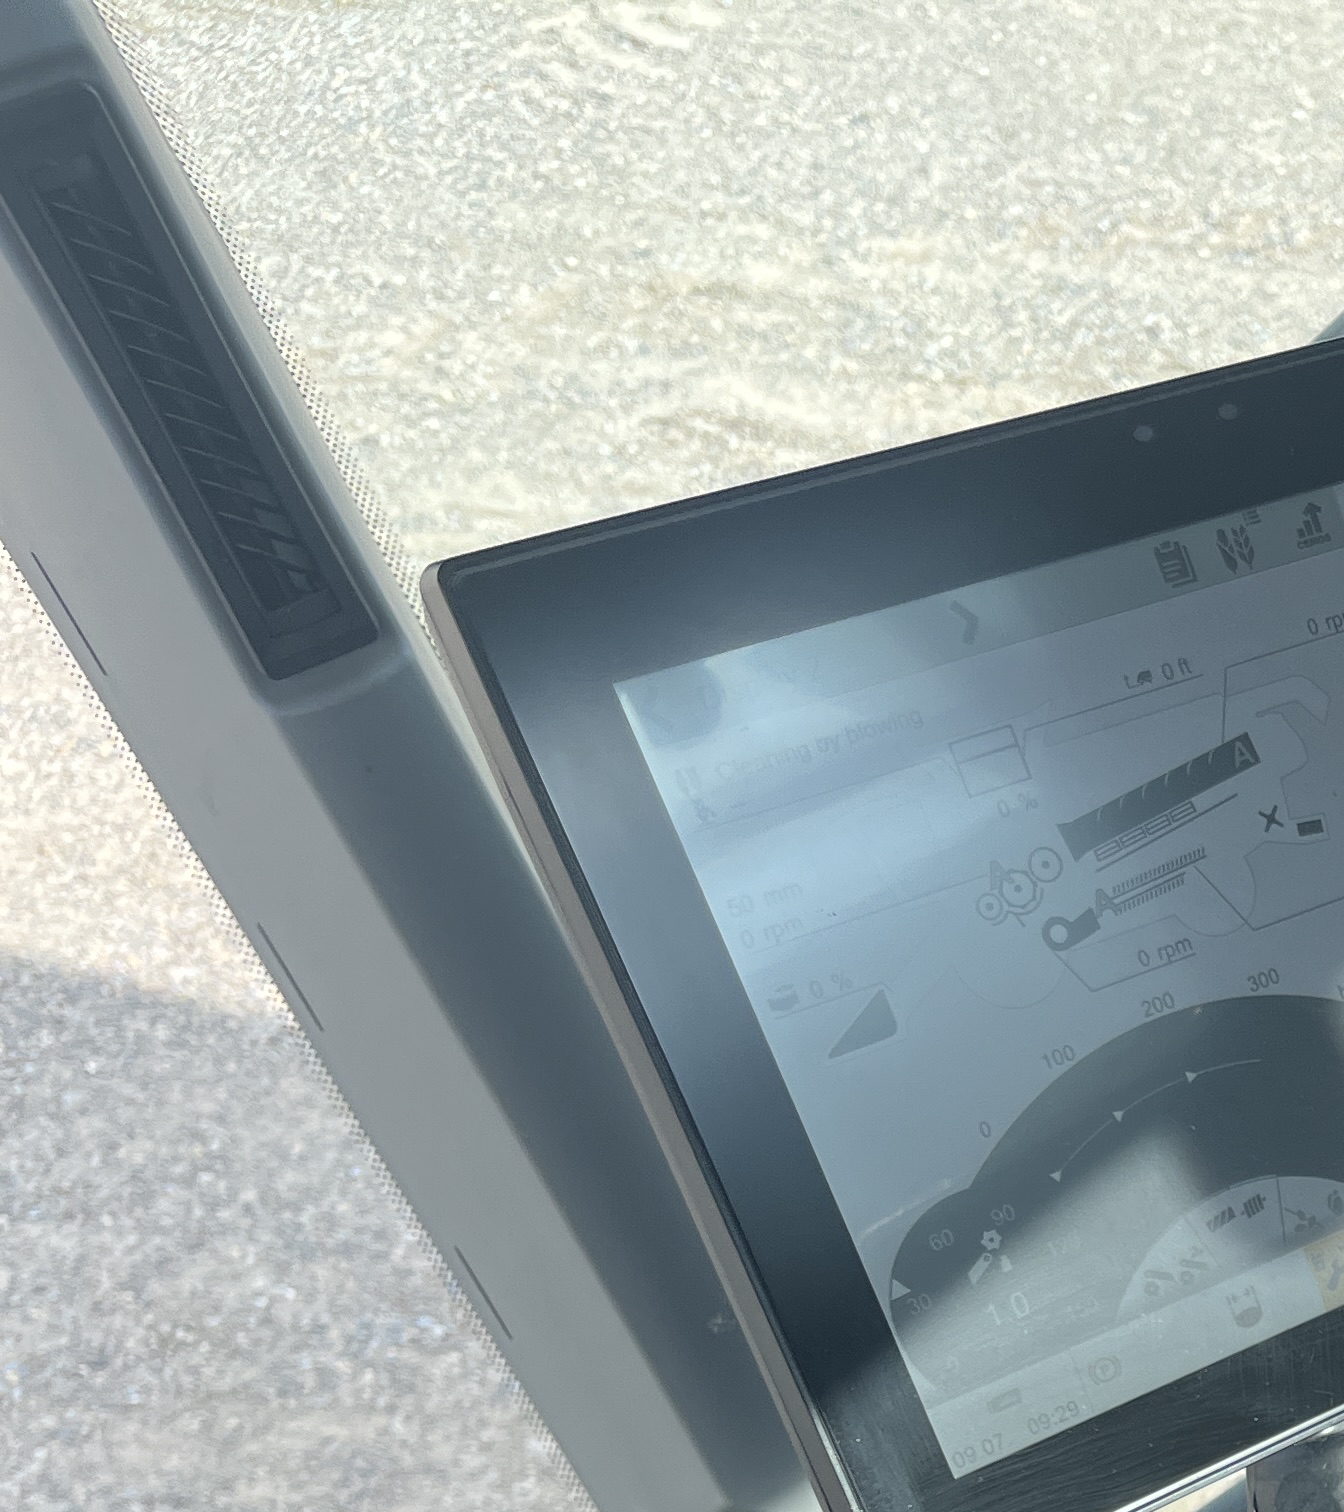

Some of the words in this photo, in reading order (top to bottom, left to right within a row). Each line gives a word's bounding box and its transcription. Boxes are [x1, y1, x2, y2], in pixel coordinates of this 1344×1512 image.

[1307, 618, 1319, 636] 0
[1162, 662, 1174, 680] 0
[1177, 658, 1193, 677] ft
[715, 743, 812, 781] Cleaning
[816, 734, 840, 755] by
[845, 709, 924, 745] blowing
[1018, 792, 1038, 811] %
[763, 882, 803, 908] mm
[764, 916, 805, 945] rpm
[1138, 949, 1150, 967] 0
[1157, 936, 1193, 965] rpm
[831, 971, 853, 991] %
[1247, 967, 1281, 993] 300
[1142, 991, 1176, 1018] 200
[1042, 1045, 1076, 1071] 100
[979, 1122, 991, 1139] 0
[990, 1204, 1016, 1226] 90
[928, 1229, 954, 1251] 60
[1027, 1400, 1080, 1435] 09:29
